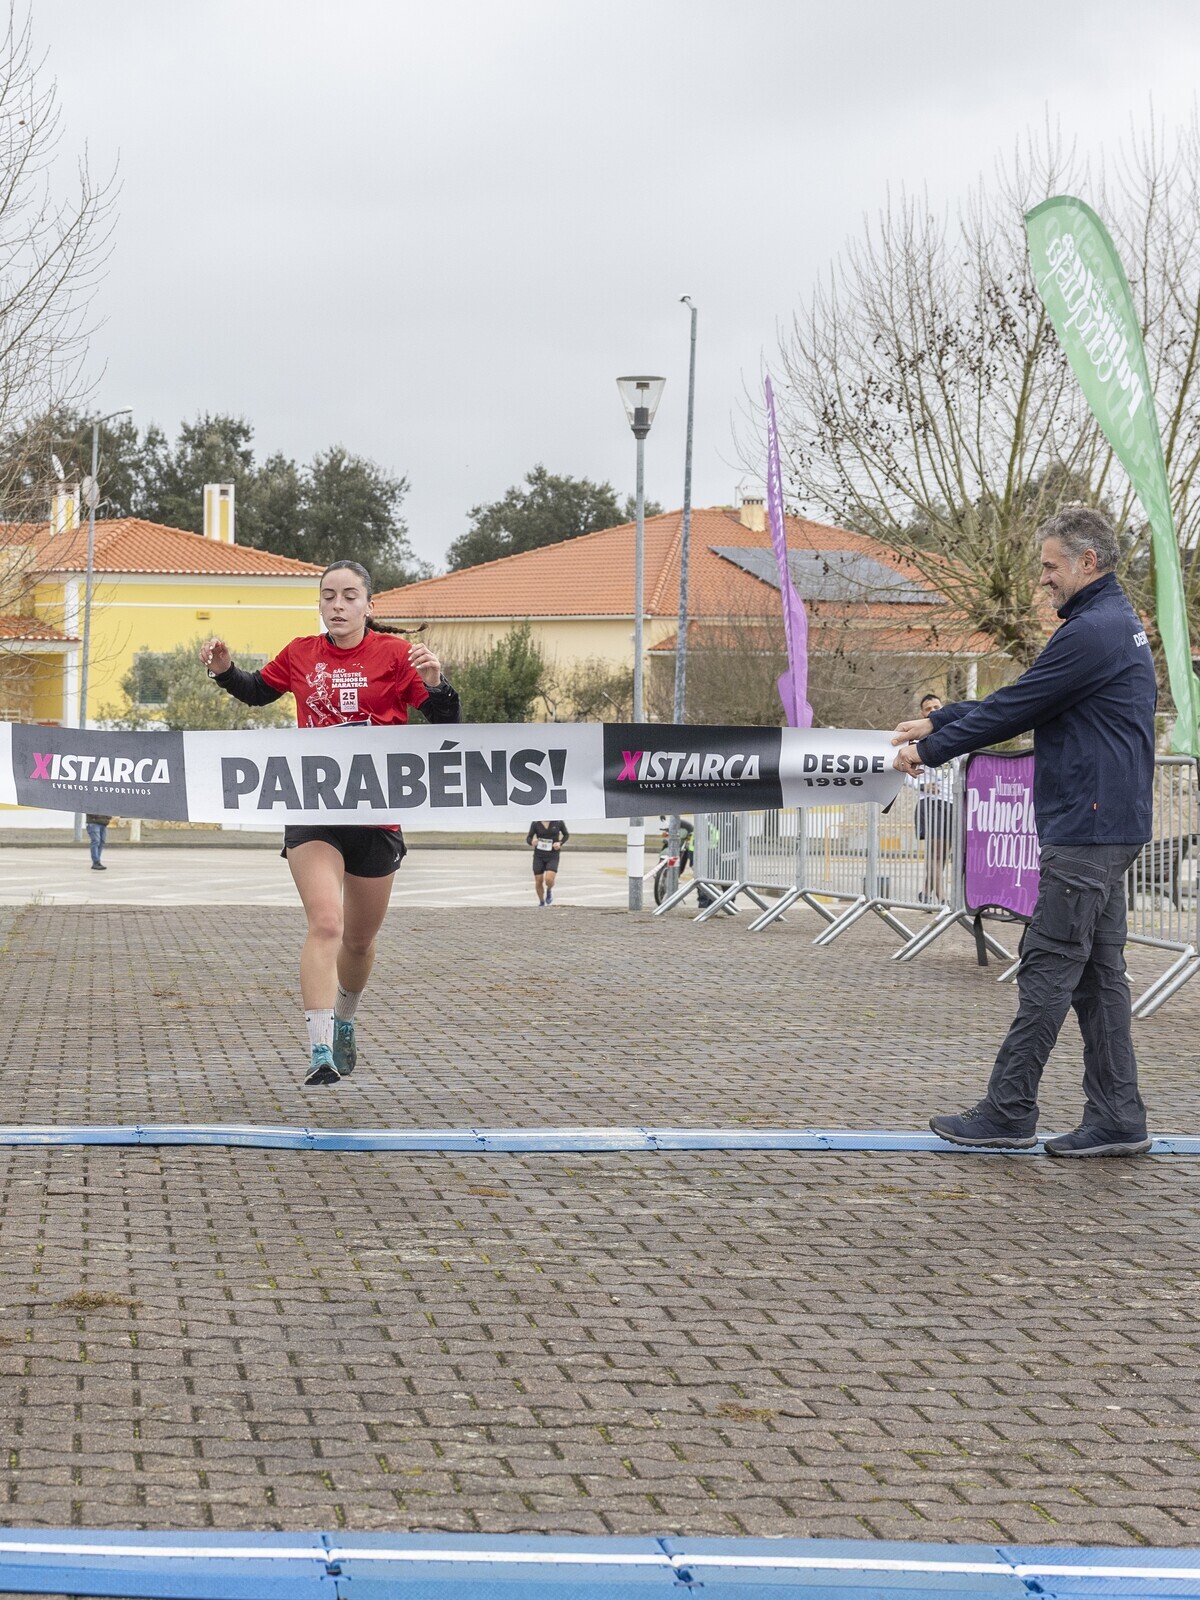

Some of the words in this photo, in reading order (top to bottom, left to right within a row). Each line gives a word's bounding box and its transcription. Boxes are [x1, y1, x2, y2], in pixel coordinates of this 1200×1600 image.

[342, 692, 356, 700] 25
[29, 752, 171, 784] XISTARCA
[220, 740, 568, 810] PARABÉNS!
[617, 751, 761, 781] XISTARCA
[803, 753, 885, 774] DESDE
[52, 783, 89, 792] EVENTOS
[93, 786, 152, 795] DESPORTIVOS
[803, 776, 864, 787] 1986
[987, 833, 1041, 887] conquis
